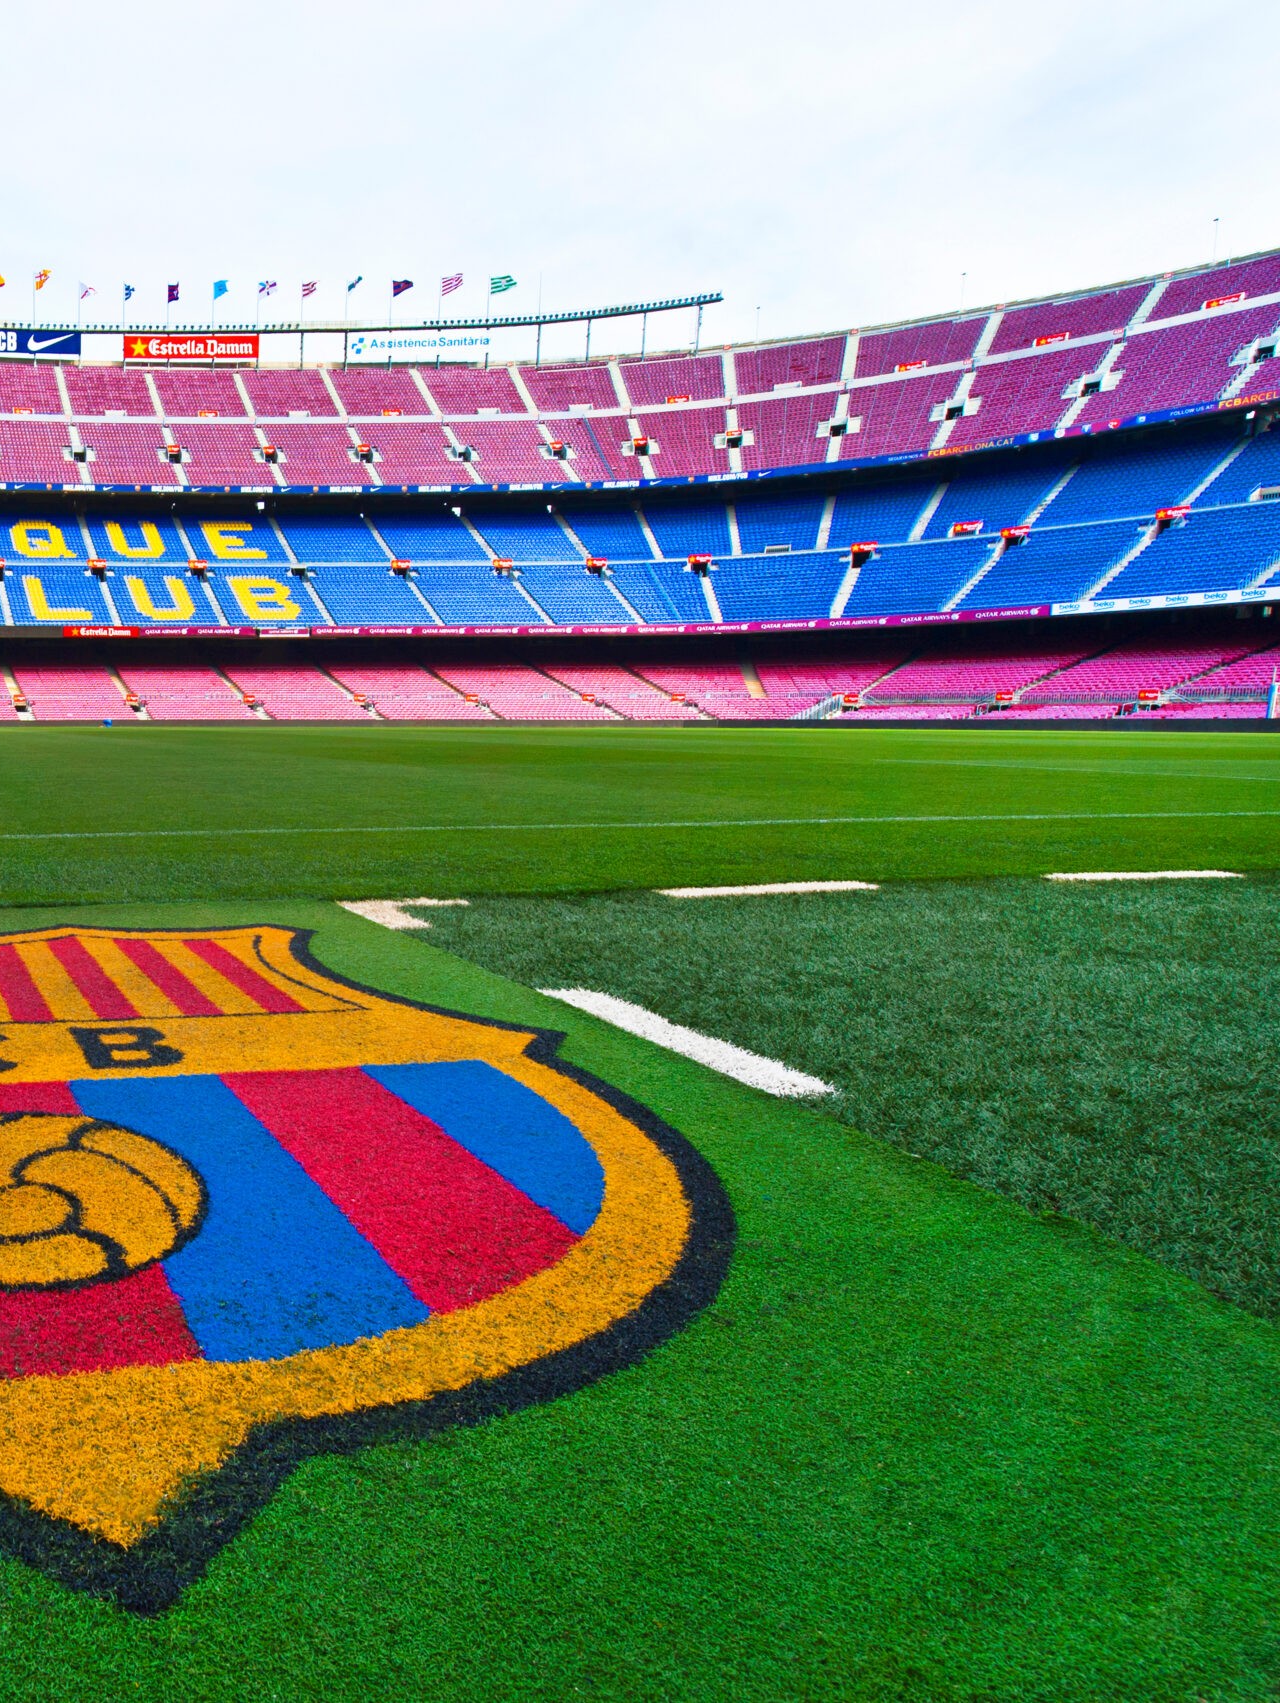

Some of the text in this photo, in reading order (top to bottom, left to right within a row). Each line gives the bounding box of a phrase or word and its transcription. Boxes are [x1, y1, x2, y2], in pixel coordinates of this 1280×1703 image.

[370, 336, 490, 348] Assistència Sanitària
[148, 338, 253, 356] Estrella Damm
[927, 438, 1014, 457] FCBARCELONA.CAT
[10, 520, 268, 559] QUE
[1203, 592, 1227, 600] beko
[1241, 588, 1266, 597] beko
[1128, 597, 1151, 605] beko
[1165, 595, 1188, 603] beko
[1093, 600, 1114, 608] beko
[108, 627, 131, 636] Damm
